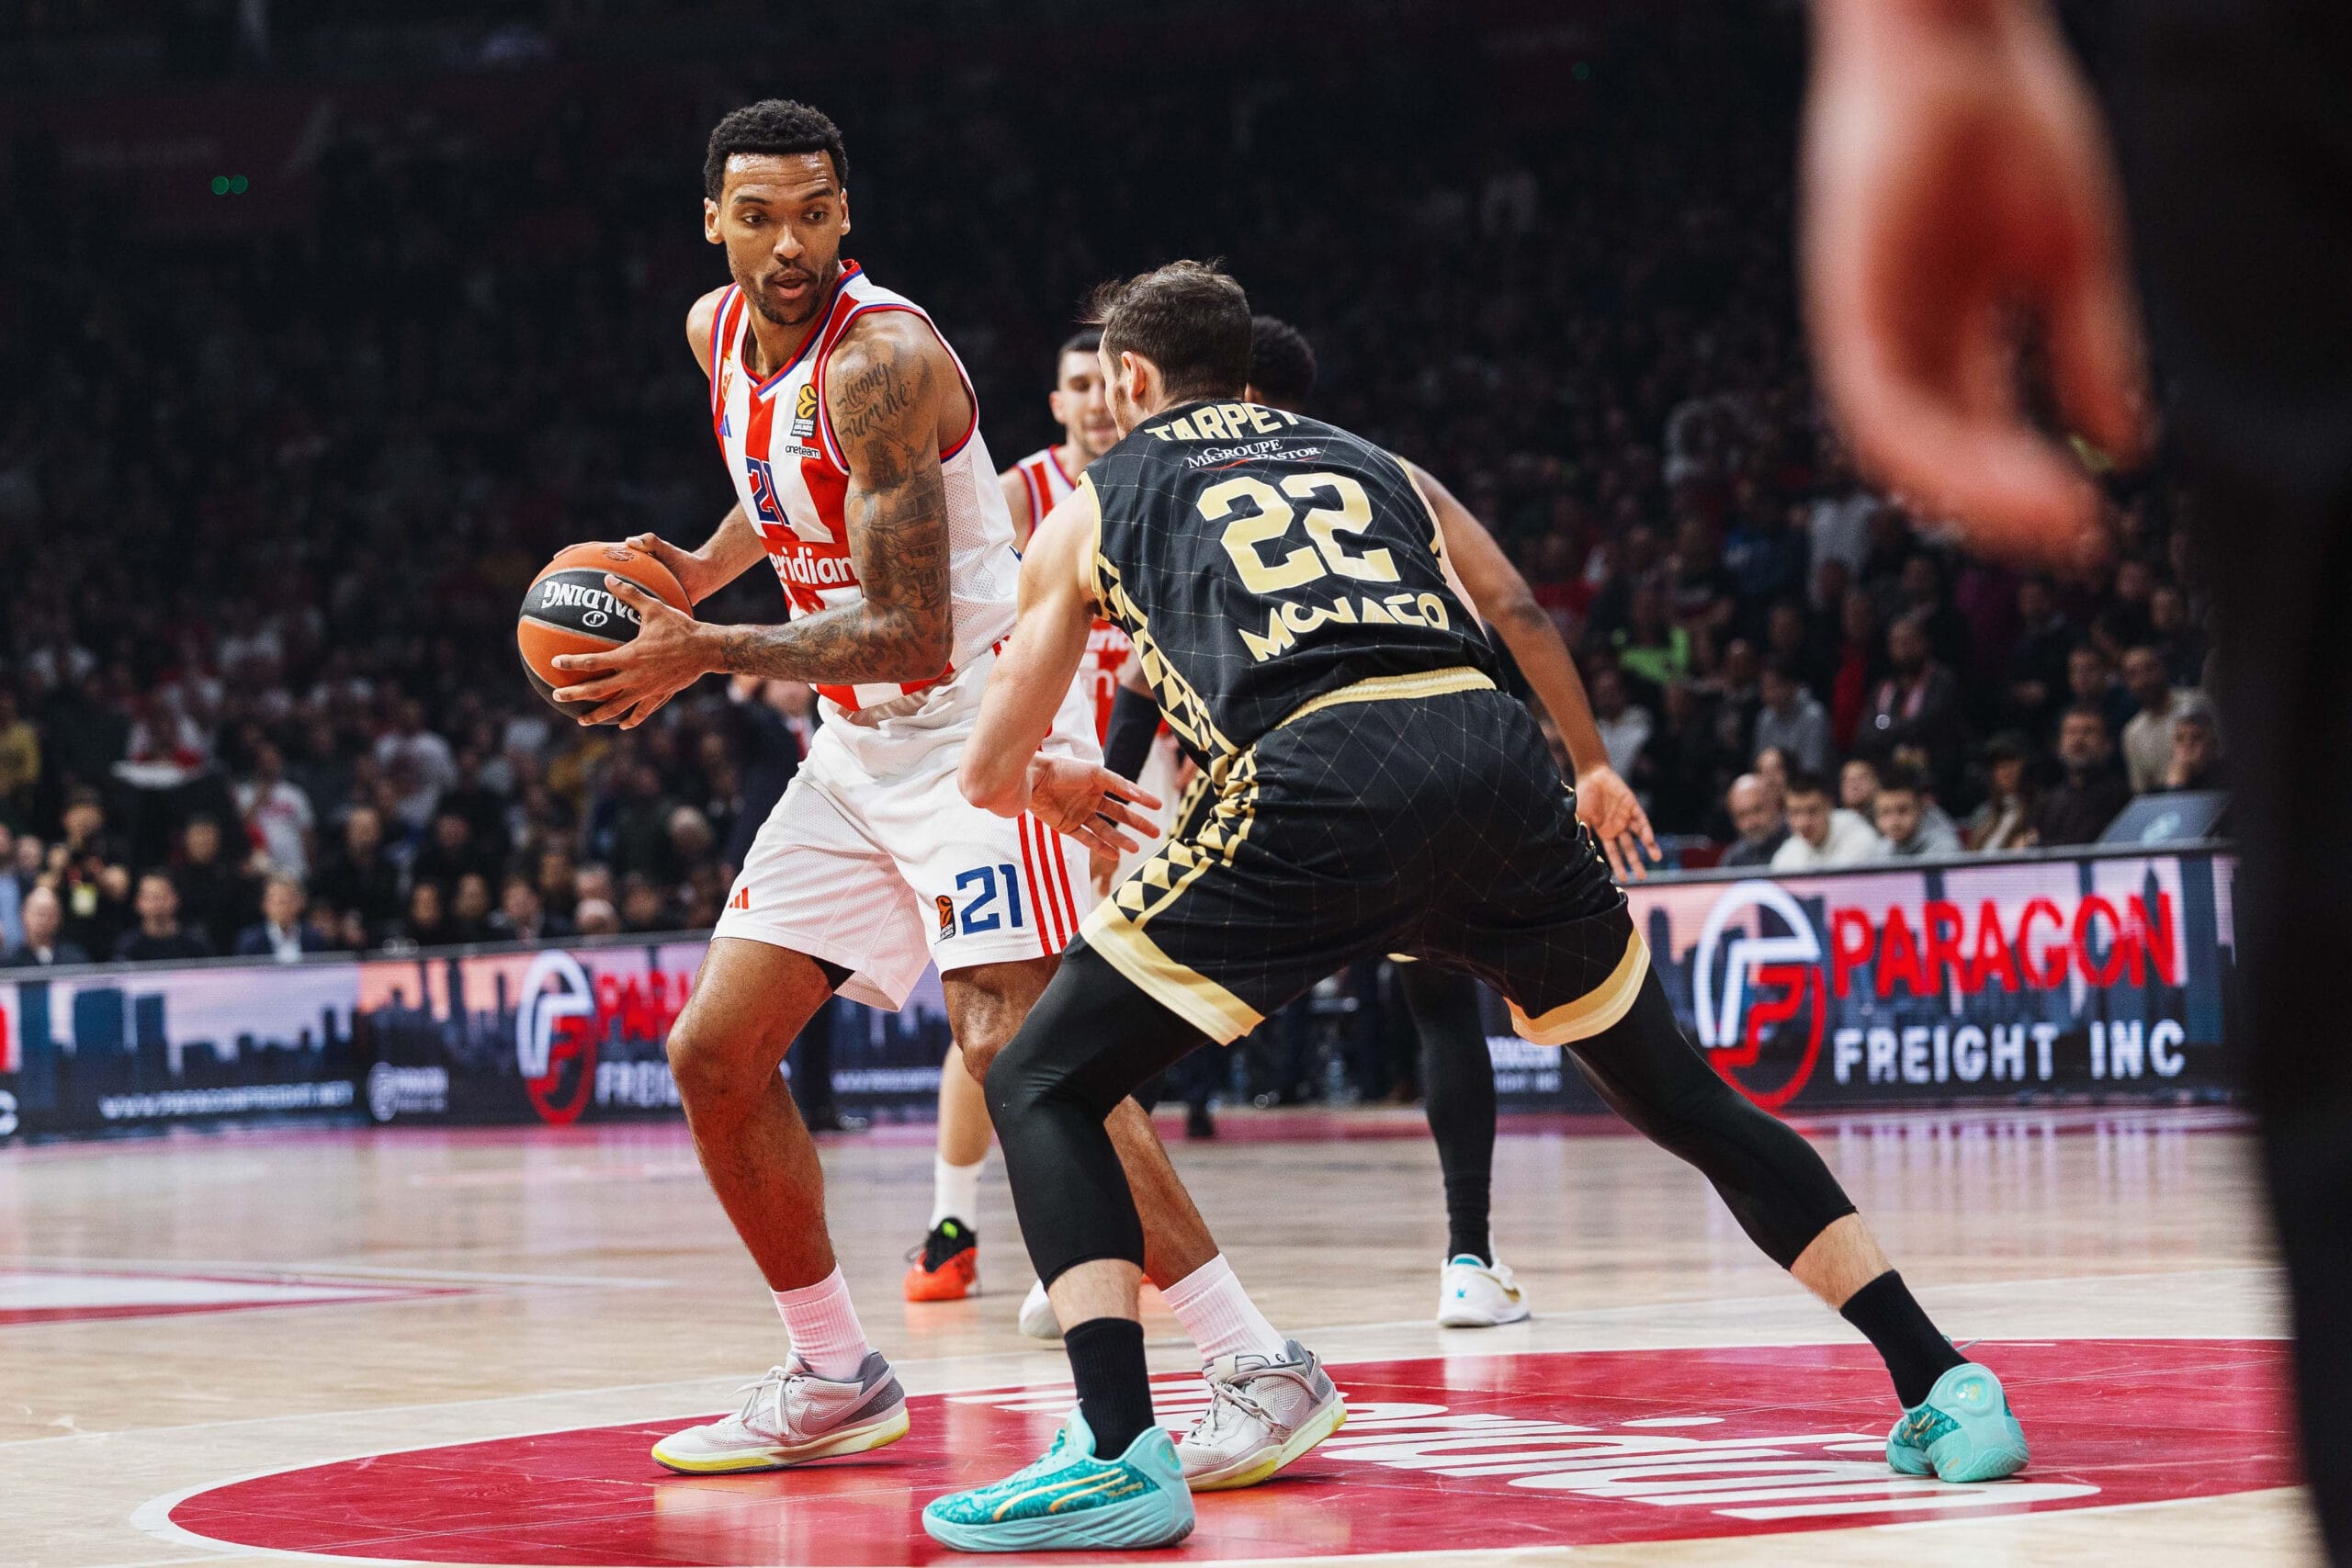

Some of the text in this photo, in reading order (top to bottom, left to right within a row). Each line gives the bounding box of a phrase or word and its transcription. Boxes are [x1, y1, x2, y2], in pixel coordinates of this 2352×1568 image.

[1204, 439, 1283, 460] GROUPE
[746, 456, 792, 526] 21
[769, 547, 858, 584] eridian
[1196, 472, 1401, 594] 22
[541, 581, 641, 625] PALDING
[1238, 592, 1450, 663] MONACO
[956, 863, 1023, 936] 21
[1832, 890, 2176, 998] PARAGON
[1834, 1018, 2186, 1084] FREIGHT INC
